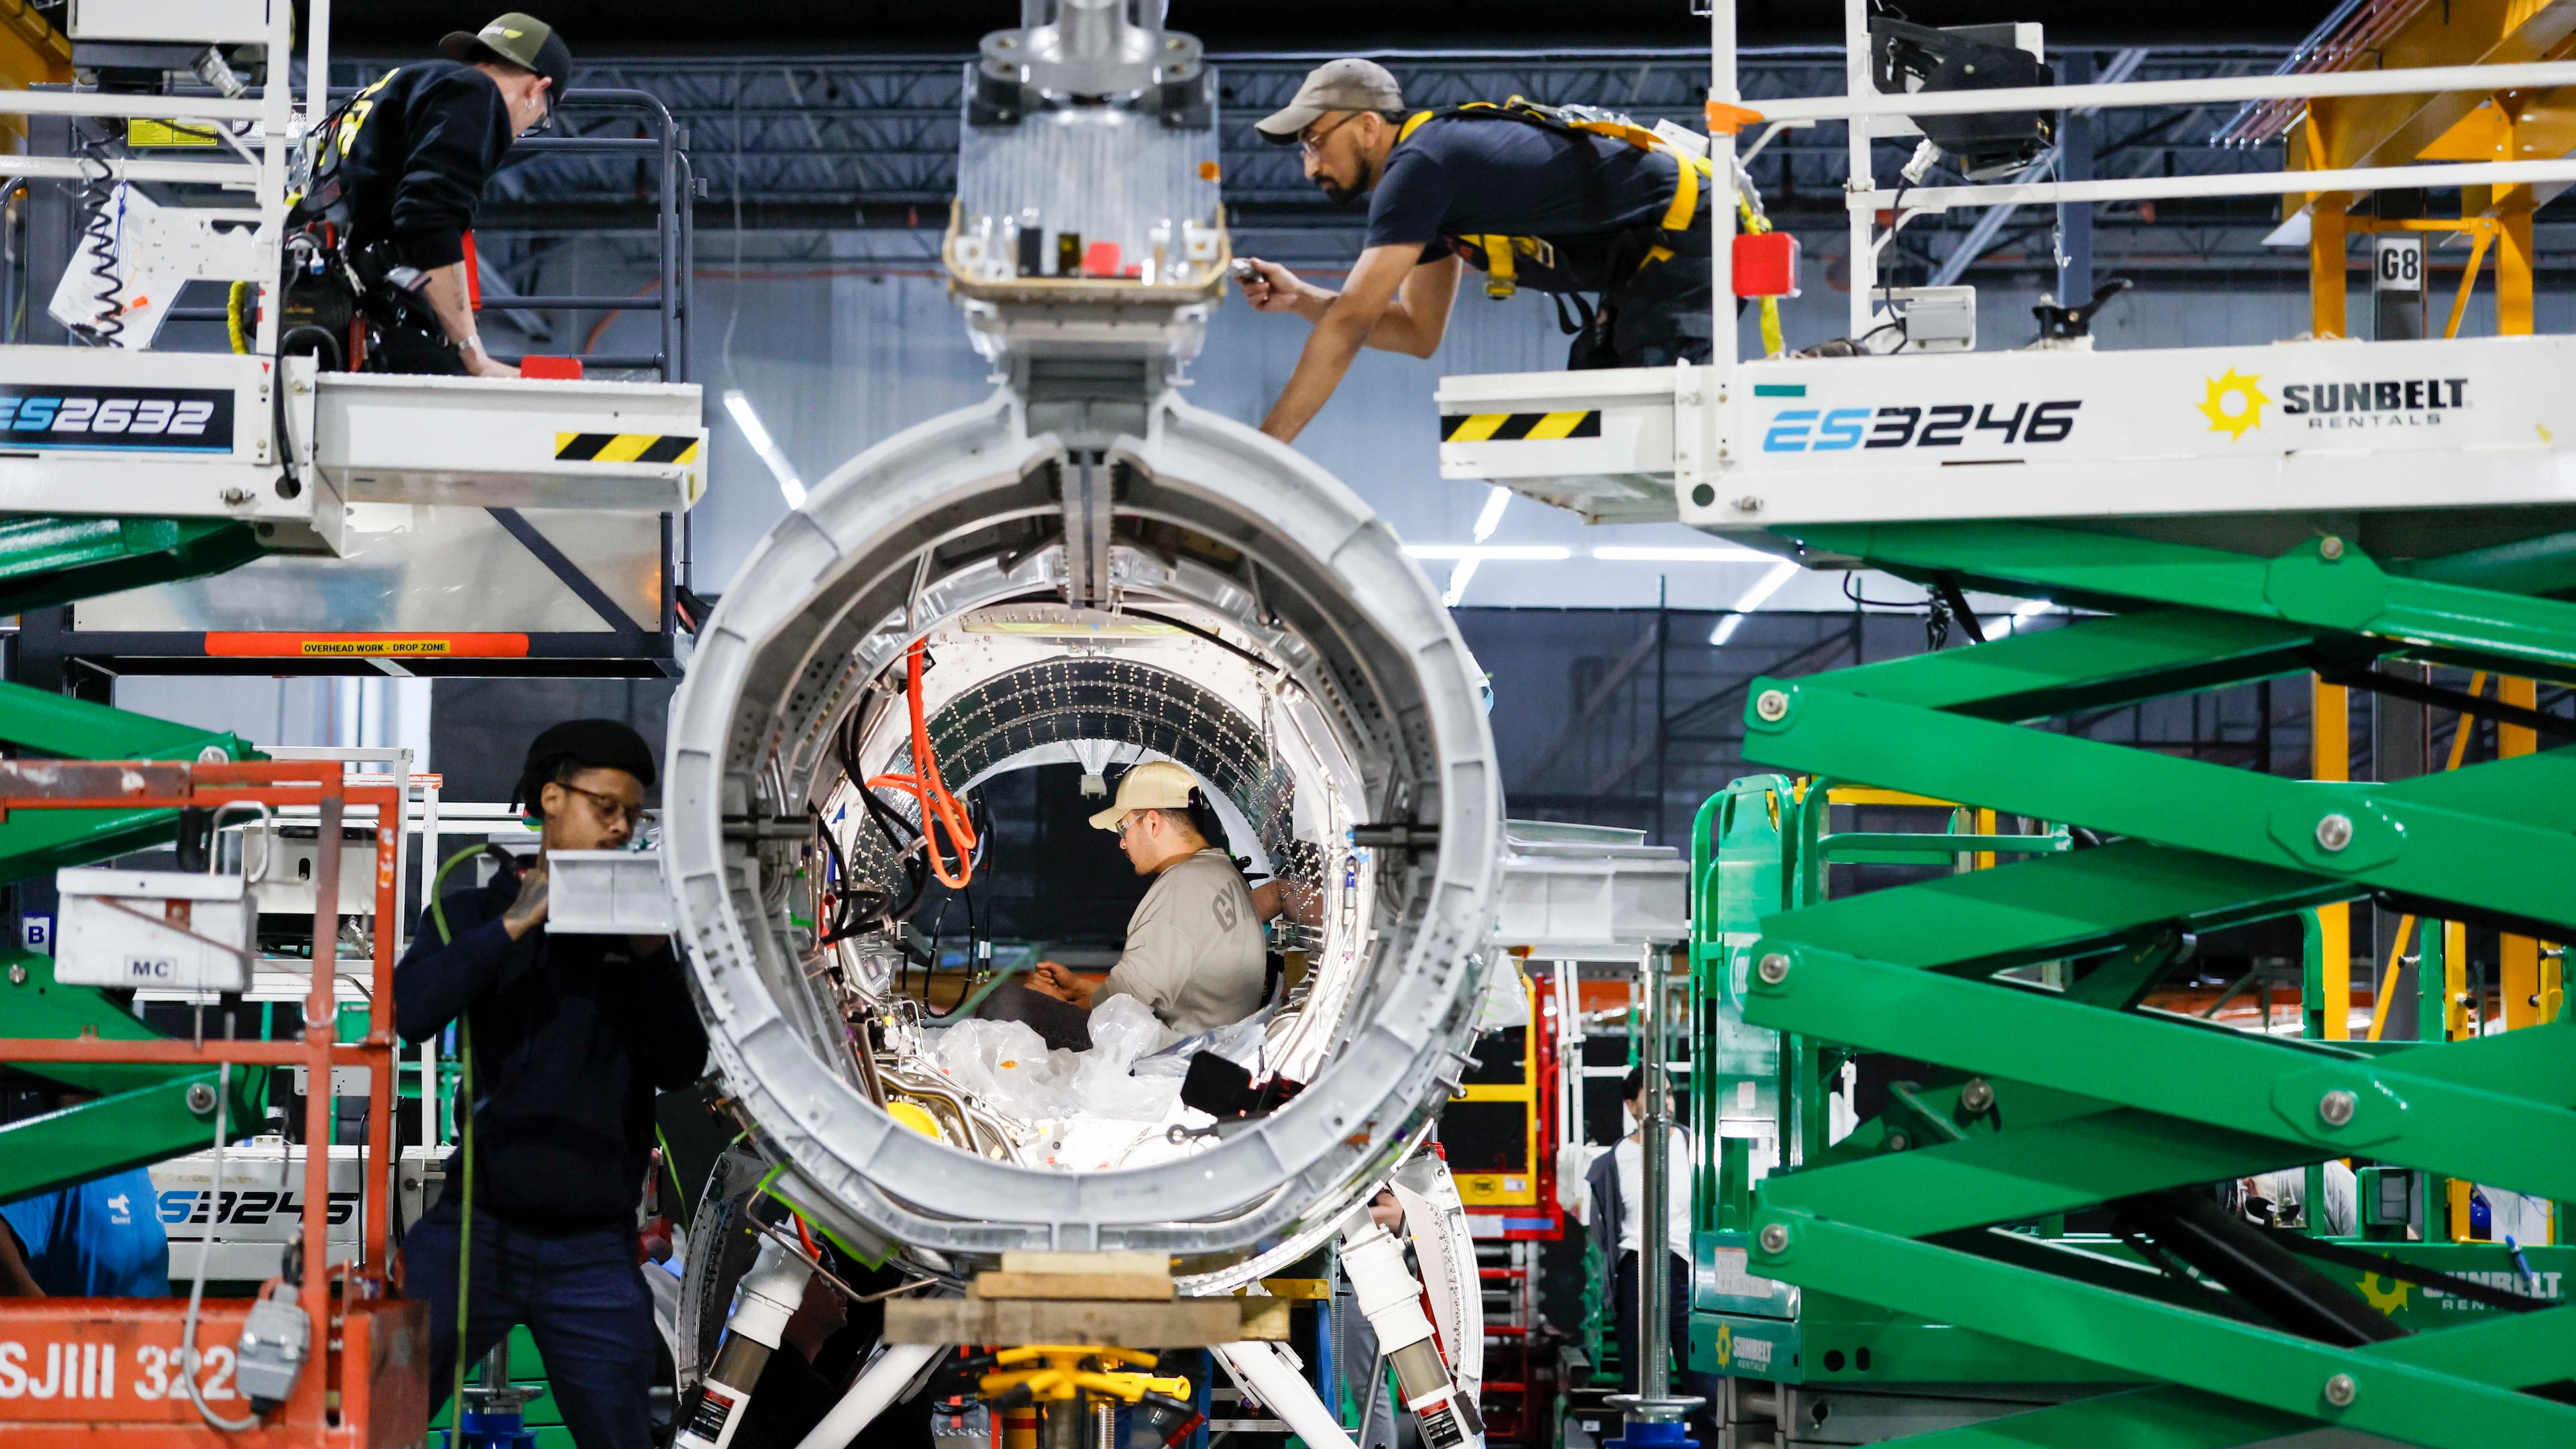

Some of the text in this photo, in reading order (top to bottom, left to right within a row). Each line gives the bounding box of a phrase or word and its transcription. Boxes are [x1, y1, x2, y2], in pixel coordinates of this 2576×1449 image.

[2382, 248, 2418, 280] G8
[2284, 378, 2468, 414] SUNBELT
[1763, 400, 2082, 451] ES3246
[2308, 413, 2440, 429] RENTALS
[304, 644, 354, 652] OVERHEAD
[393, 643, 418, 651] DROP
[28, 926, 44, 944] B
[133, 961, 168, 977] MC
[134, 1344, 246, 1399] 322
